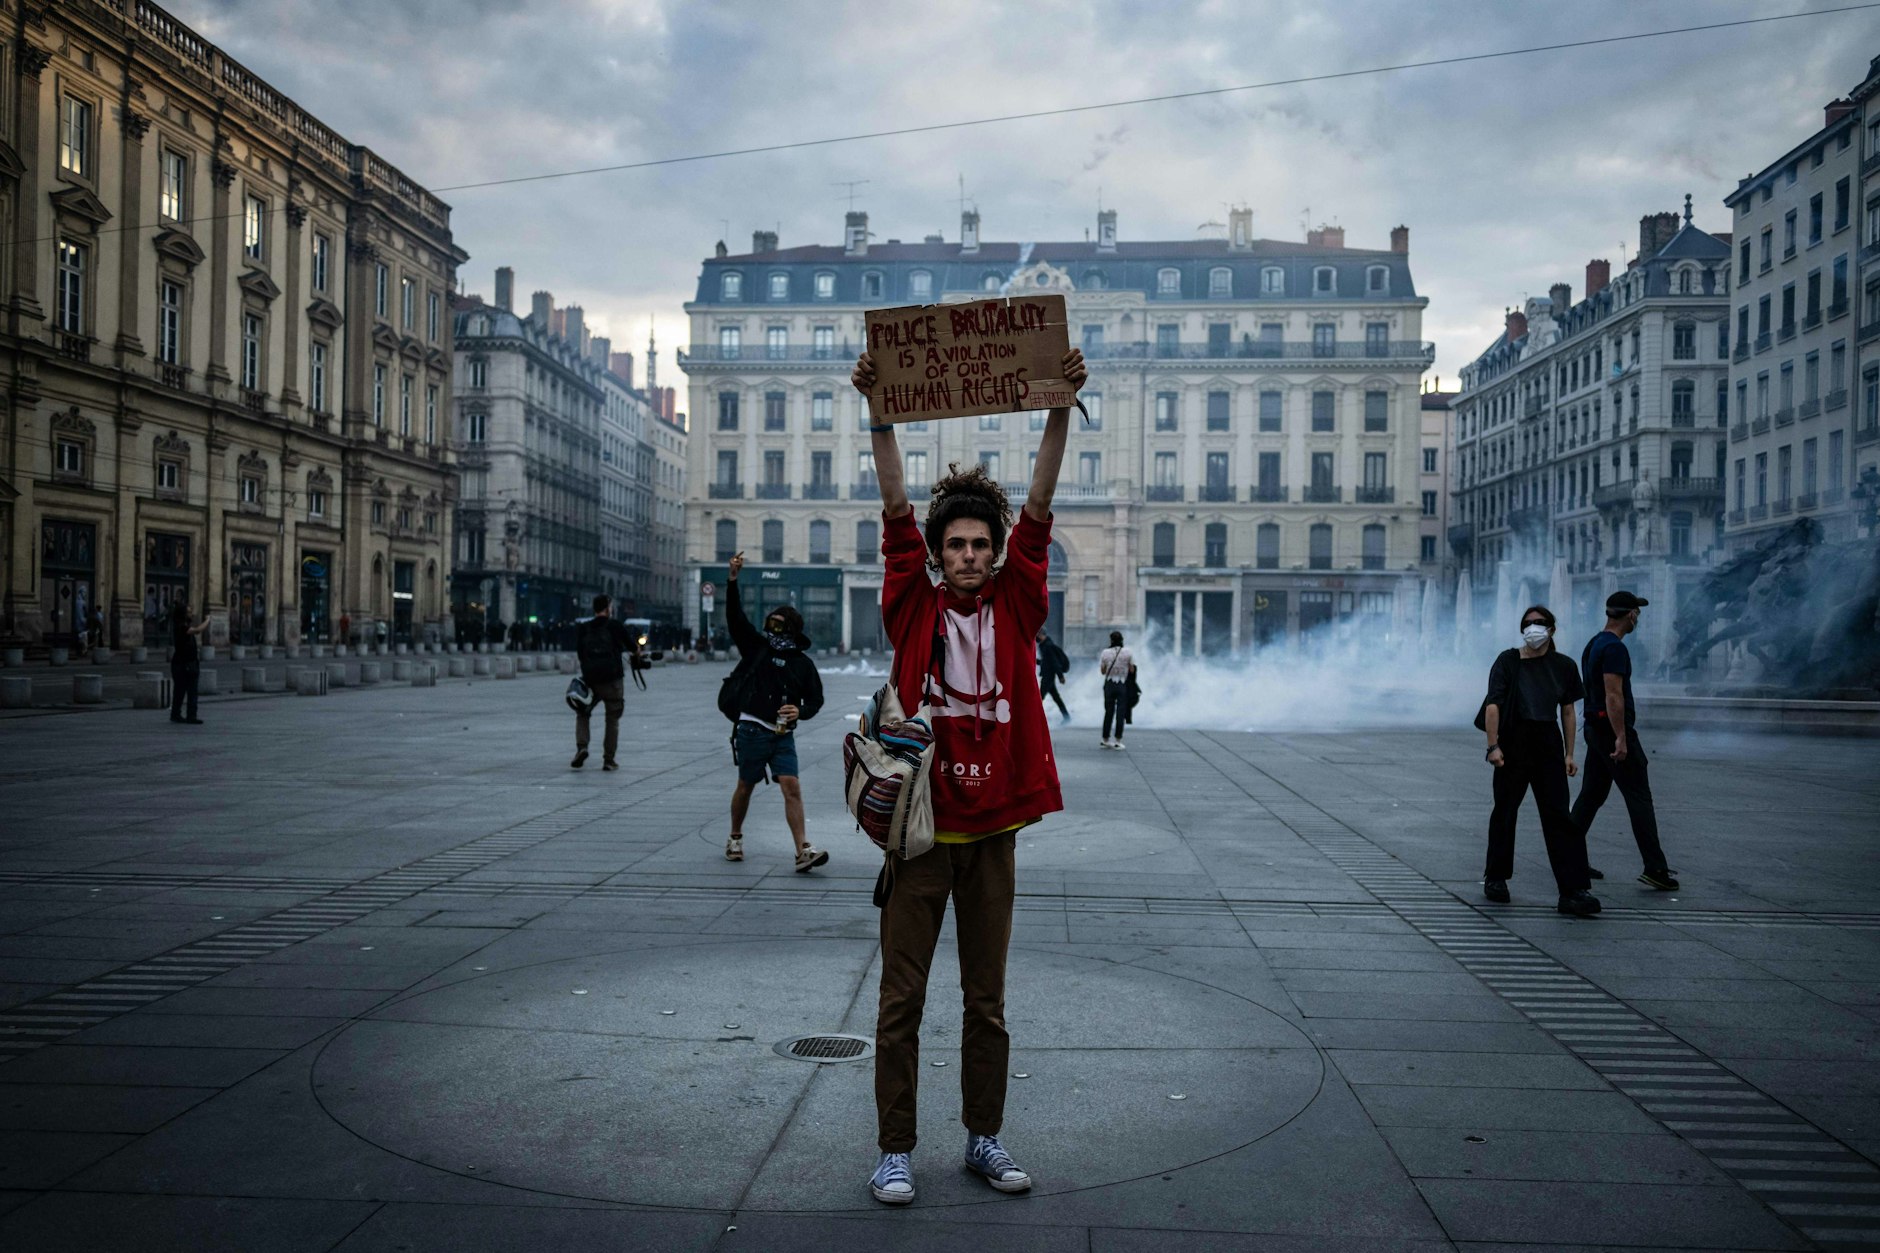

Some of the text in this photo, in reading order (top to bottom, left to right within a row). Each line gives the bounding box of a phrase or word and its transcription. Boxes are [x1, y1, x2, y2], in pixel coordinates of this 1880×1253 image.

[871, 302, 1047, 350] POLICE BRUTALITY
[898, 343, 1016, 369] IS A VIOLATION
[925, 361, 992, 379] OF OUR
[883, 367, 1029, 414] HUMAN RIGHTS
[761, 571, 780, 580] PMU
